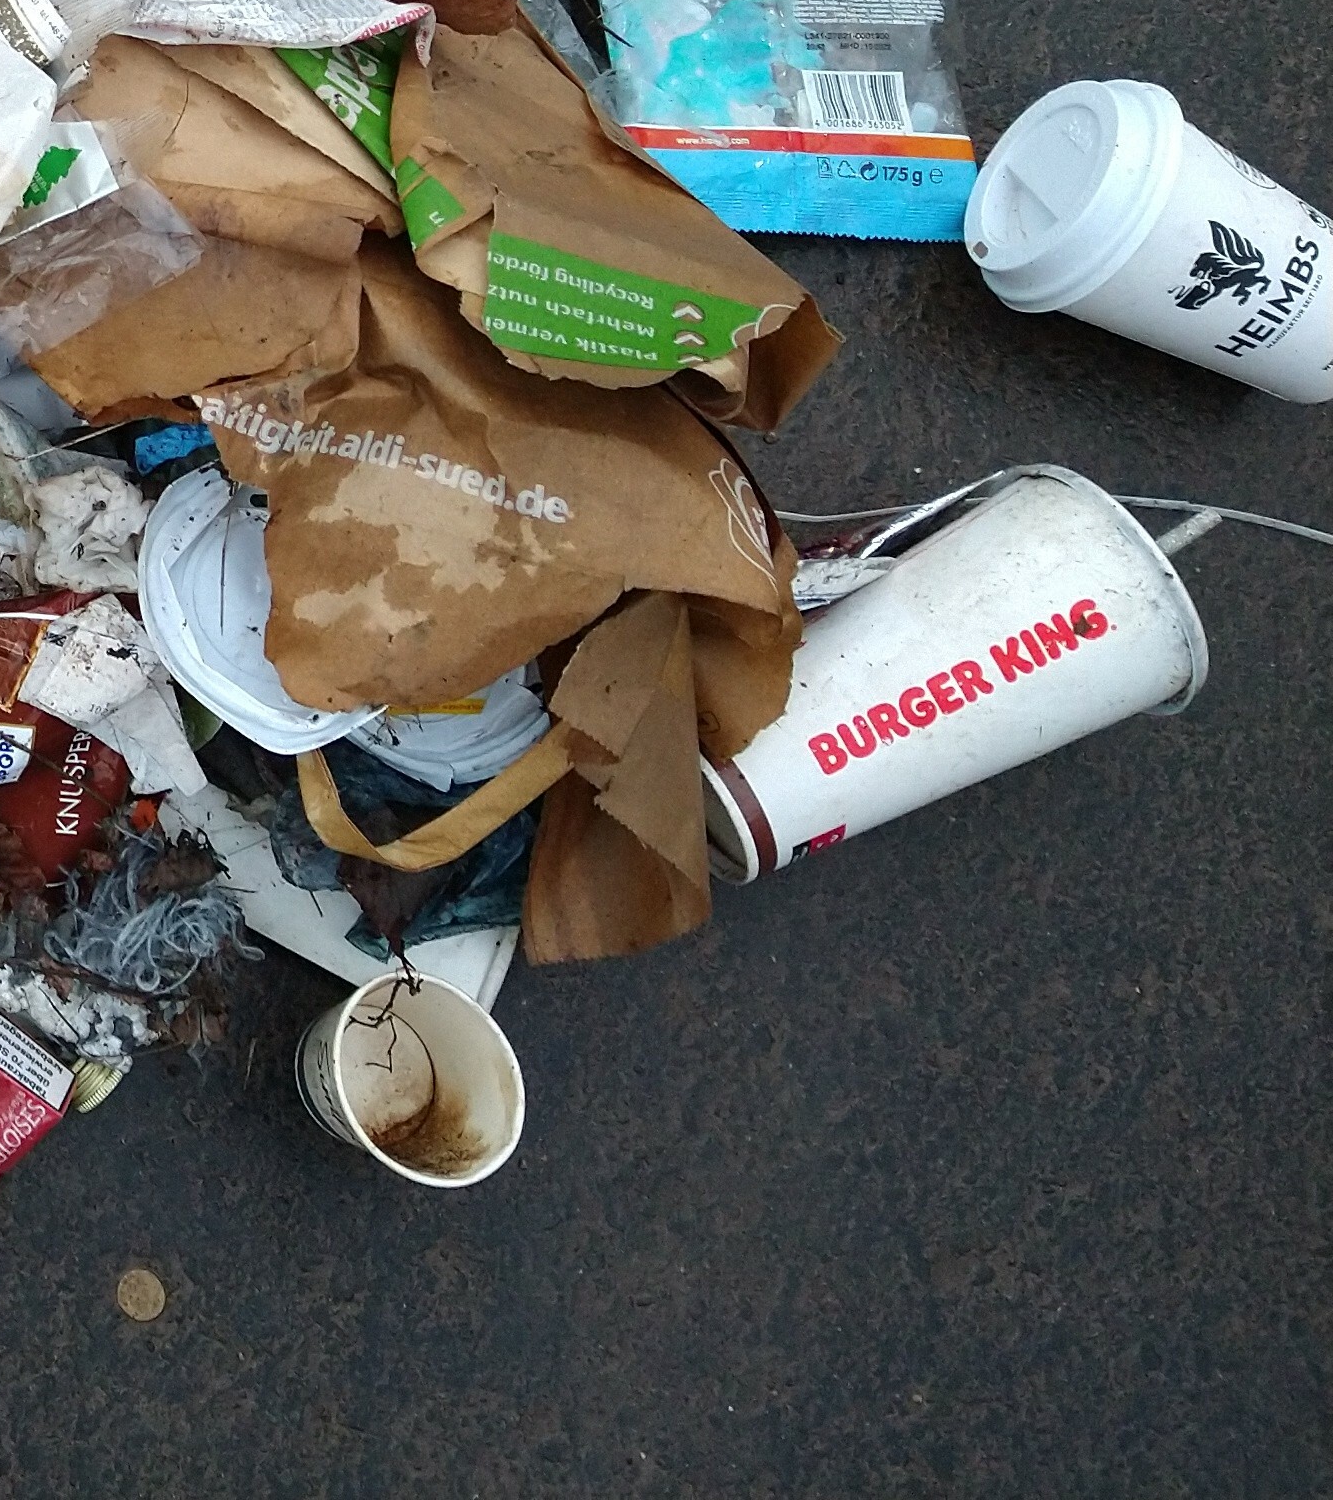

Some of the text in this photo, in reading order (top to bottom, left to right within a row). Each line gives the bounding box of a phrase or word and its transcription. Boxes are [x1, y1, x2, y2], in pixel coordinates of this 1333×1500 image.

[882, 166, 909, 182] 175
[911, 169, 923, 186] g
[554, 267, 654, 311] Recycling
[1214, 235, 1319, 358] HEIMBS
[545, 300, 655, 338] Mehrfach
[1265, 309, 1306, 349] MANUFAKTUR
[1303, 291, 1314, 309] SEIT
[575, 337, 659, 362] Plastik
[808, 599, 1109, 775] BURGER KING
[11, 1055, 25, 1067] 70
[25, 1067, 51, 1088] über
